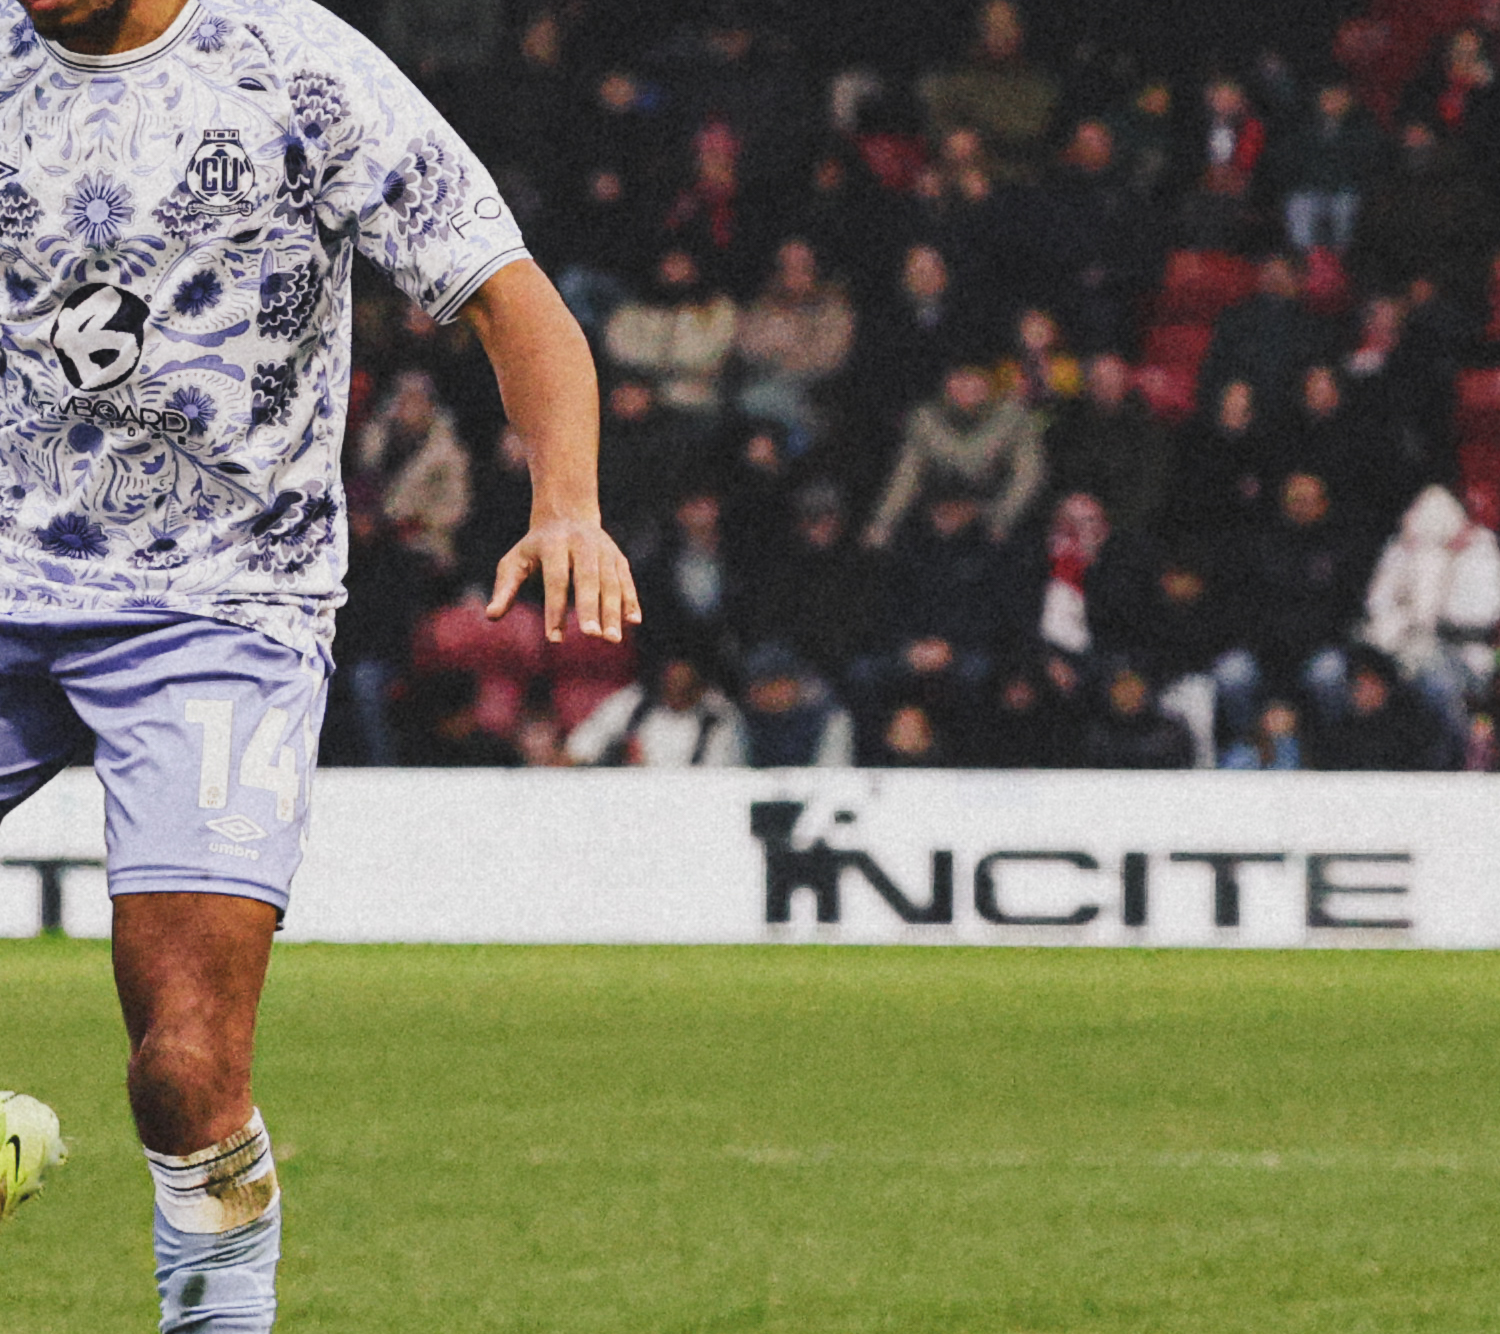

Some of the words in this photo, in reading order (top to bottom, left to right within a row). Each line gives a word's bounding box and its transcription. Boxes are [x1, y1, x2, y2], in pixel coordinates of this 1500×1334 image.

[201, 156, 239, 192] CU
[184, 698, 300, 823] 14
[208, 841, 261, 861] umbro
[764, 847, 1413, 930] INCITE
